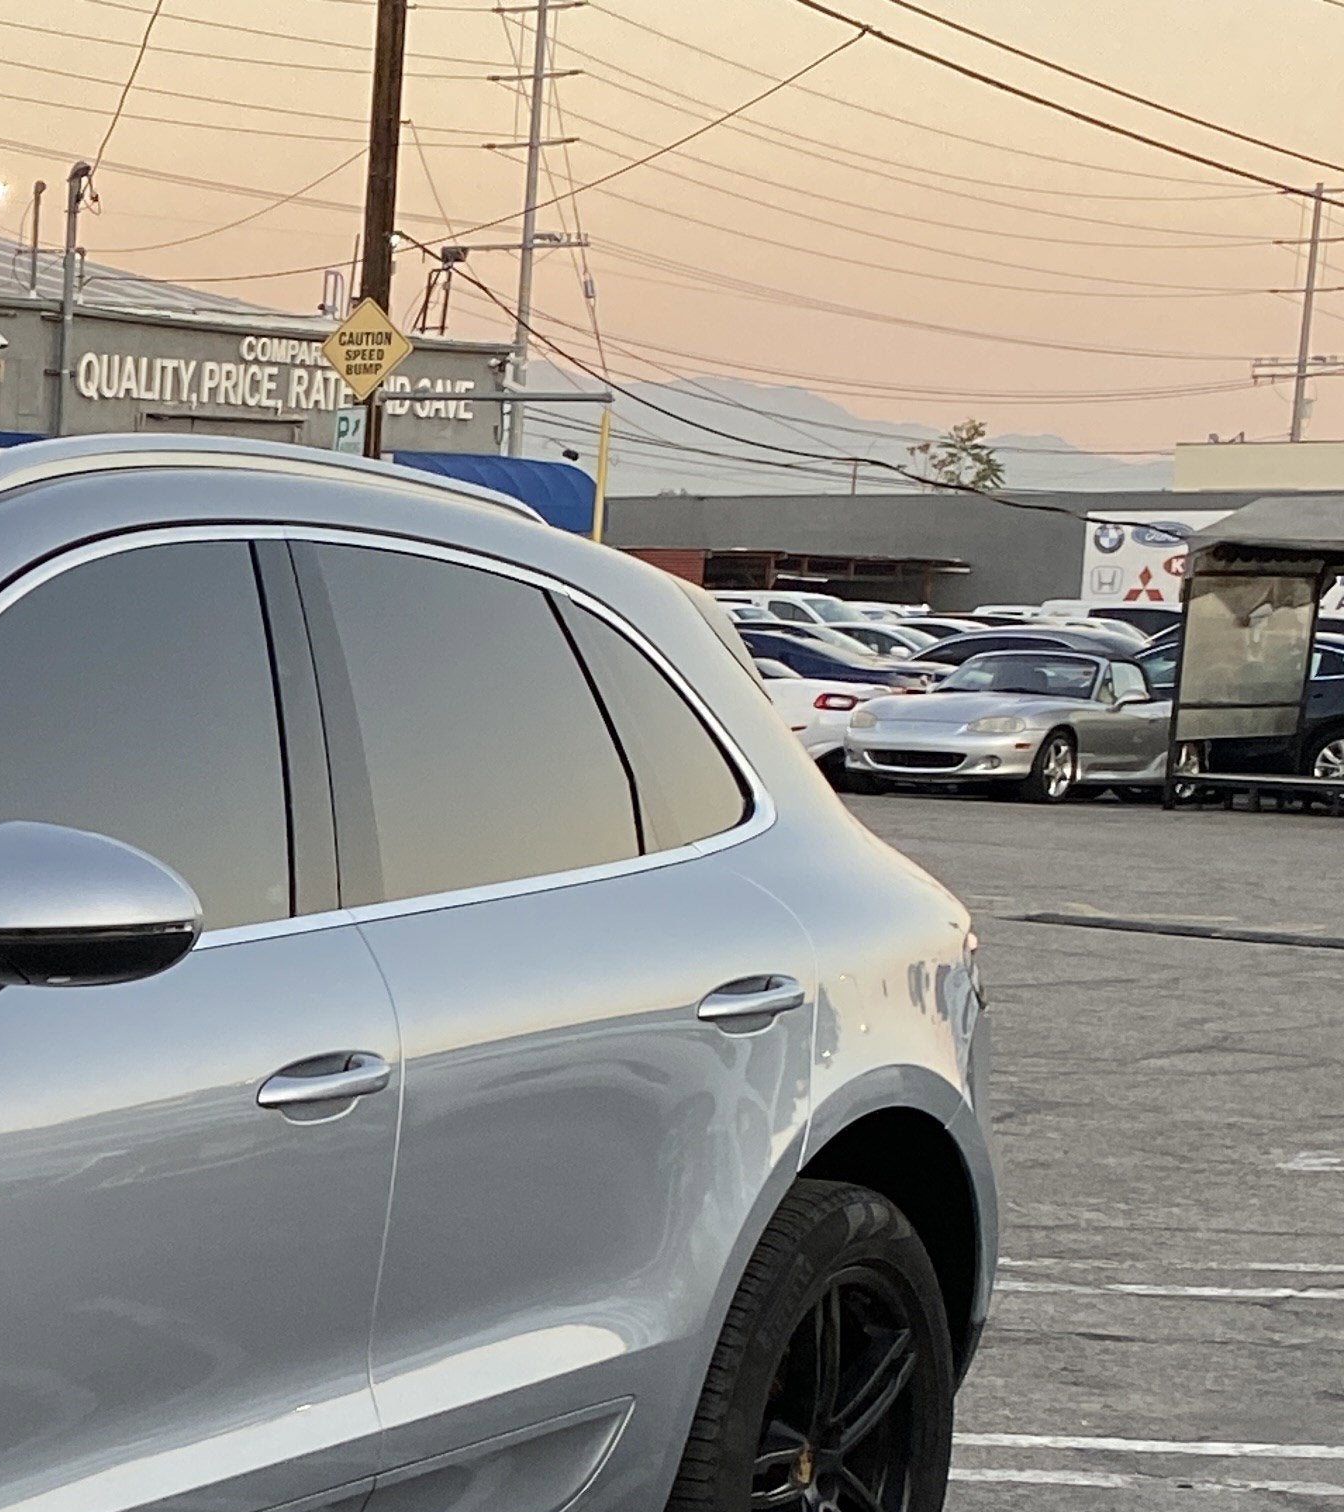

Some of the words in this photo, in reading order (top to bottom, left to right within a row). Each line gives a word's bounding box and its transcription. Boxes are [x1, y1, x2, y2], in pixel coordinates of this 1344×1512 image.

[338, 331, 392, 346] CAUTION
[345, 349, 385, 361] SPEED
[345, 363, 382, 376] BUMP
[413, 377, 475, 420] SAVE
